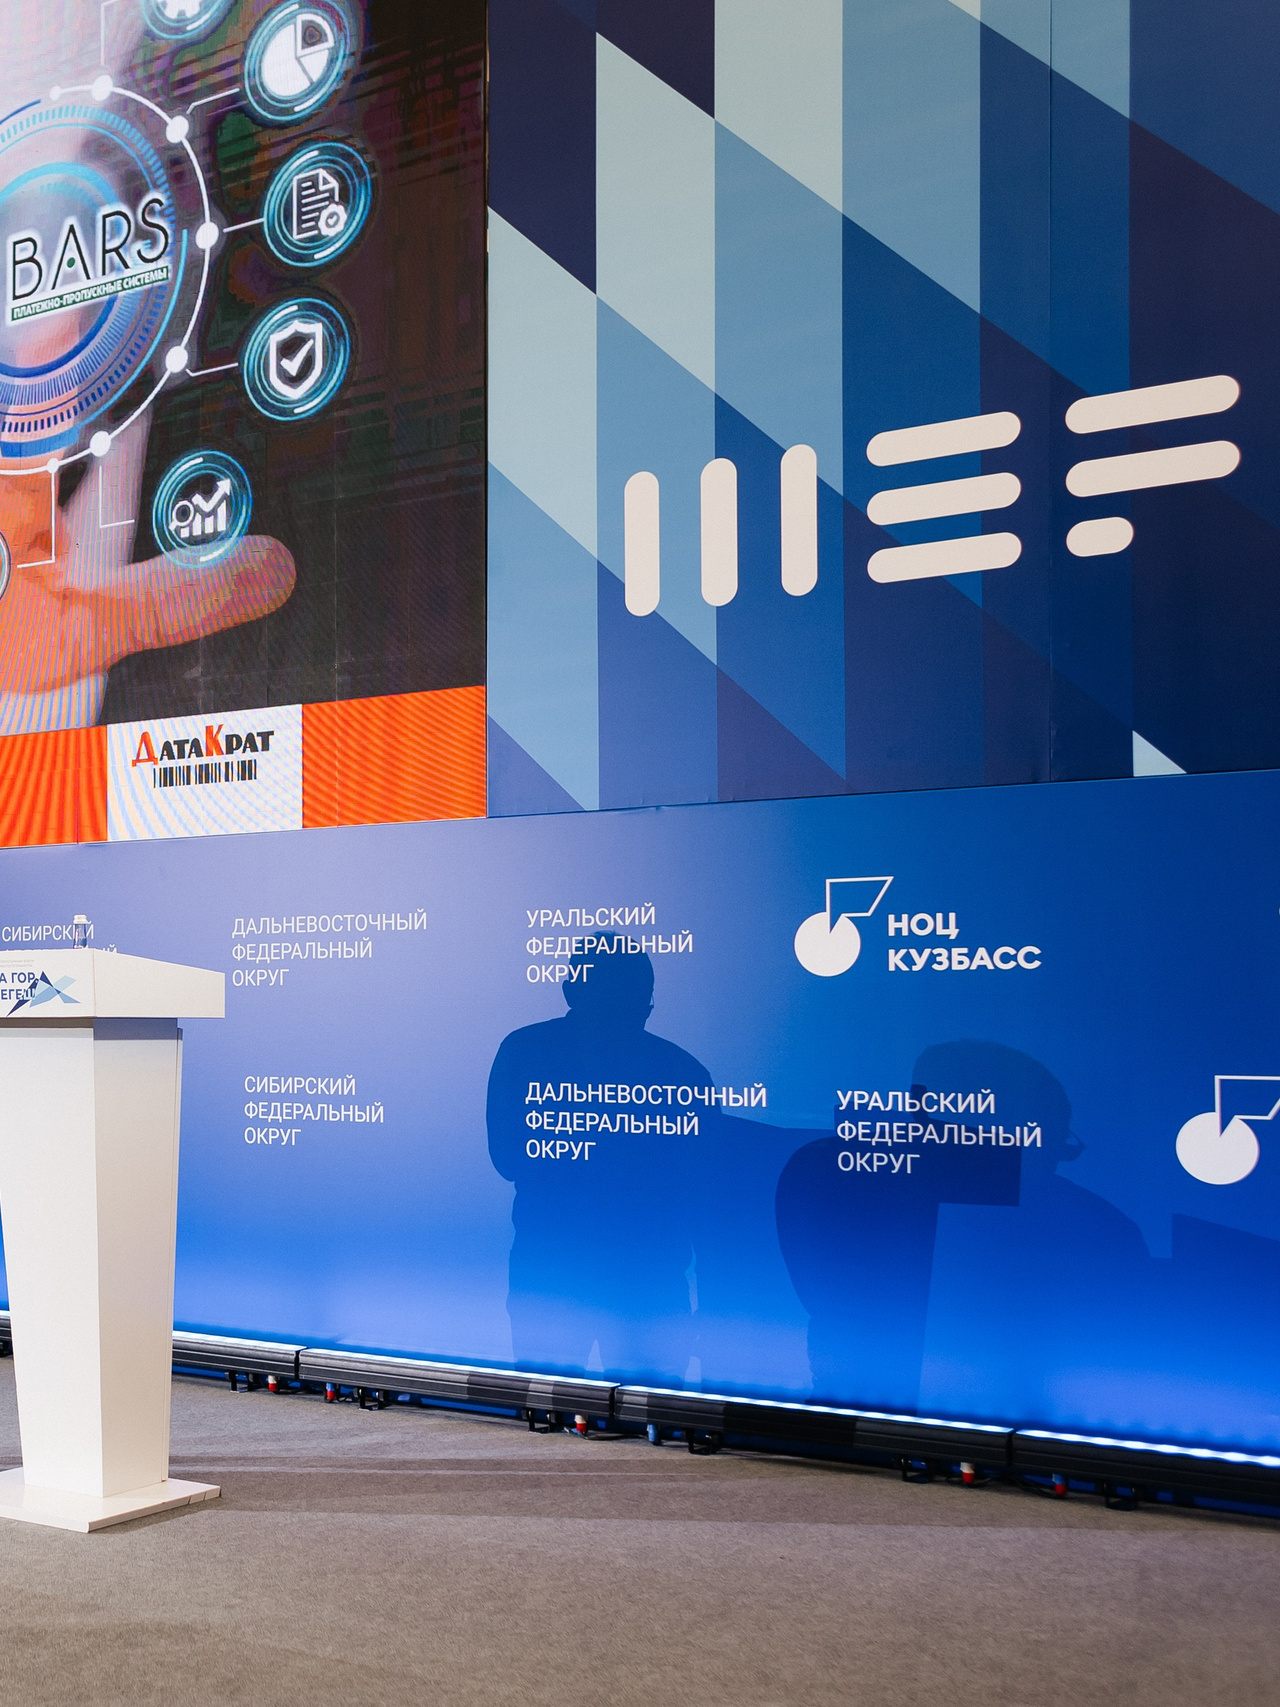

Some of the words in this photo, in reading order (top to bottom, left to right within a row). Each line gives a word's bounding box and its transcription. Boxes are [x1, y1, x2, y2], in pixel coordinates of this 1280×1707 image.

[12, 198, 169, 301] BARS
[13, 279, 122, 318] ПЛАТЕЖНО-ПРОПУСКНЫЕ
[123, 268, 167, 289] СИСТЕМЫ
[232, 908, 427, 938] ДАЛЬНЕВОСТОЧНЫЙ
[526, 902, 656, 928] УРАЛЬСКИЙ
[888, 912, 960, 939] НОЦ
[232, 937, 373, 963] ФЕДЕРАЛЬНЫЙ
[526, 930, 693, 958] ФЕДЕРАЛЬНЫЙ
[888, 946, 1042, 971] КУЗБАСС
[11, 971, 36, 984] ГОР
[232, 969, 289, 986] ОКРУГ
[526, 964, 594, 983] ОКРУГ
[244, 1074, 356, 1095] СИБИРСКИЙ
[525, 1082, 767, 1107] ДАЛЬНЕВОСТОЧНЫЙ
[244, 1101, 384, 1123] ФЕДЕРАЛЬНЫЙ
[837, 1088, 995, 1114] УРАЛЬСКИЙ
[525, 1110, 699, 1135] ФЕДЕРАЛЬНЫЙ
[837, 1120, 1042, 1147] ФЕДЕРАЛЬНЫЙ
[244, 1127, 301, 1146] ОКРУГ
[526, 1139, 596, 1160] ОКРУГ
[837, 1151, 920, 1174] ОКРУГ
